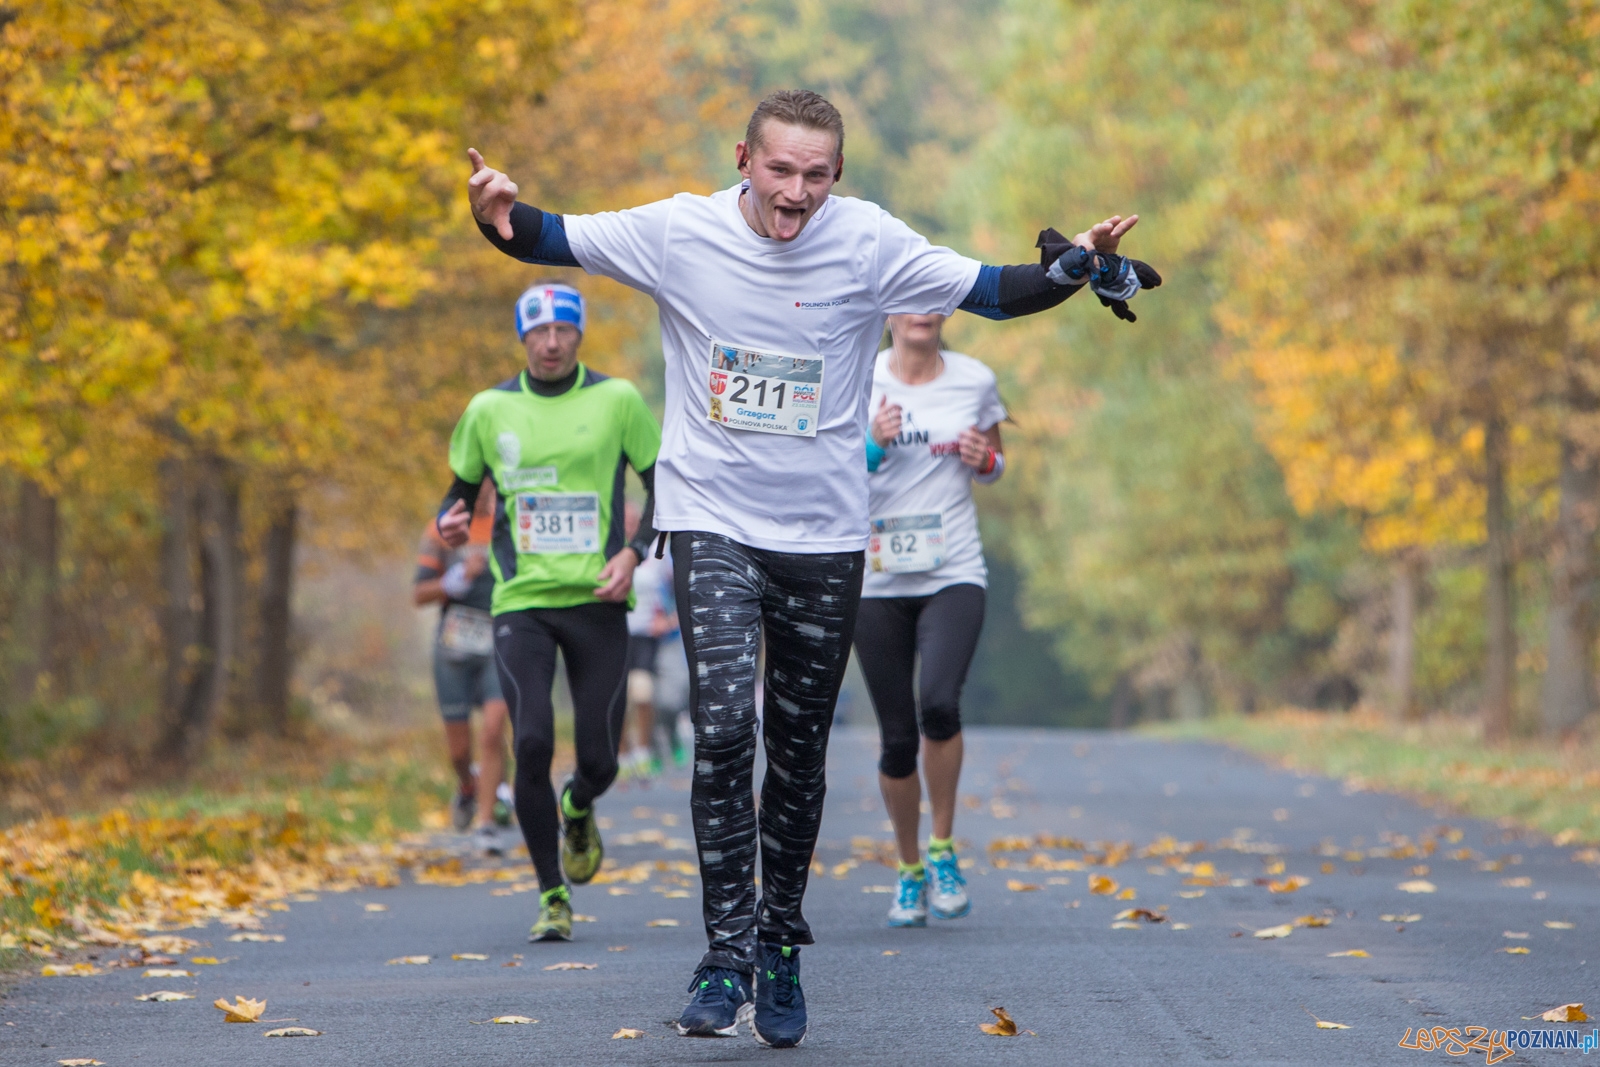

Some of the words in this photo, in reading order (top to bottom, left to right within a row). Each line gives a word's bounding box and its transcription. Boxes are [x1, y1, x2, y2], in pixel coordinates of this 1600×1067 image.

[729, 375, 786, 409] 211
[729, 418, 761, 427] POLINOVA
[736, 407, 776, 420] Grzegorz
[535, 515, 573, 534] 381
[890, 533, 917, 554] 62
